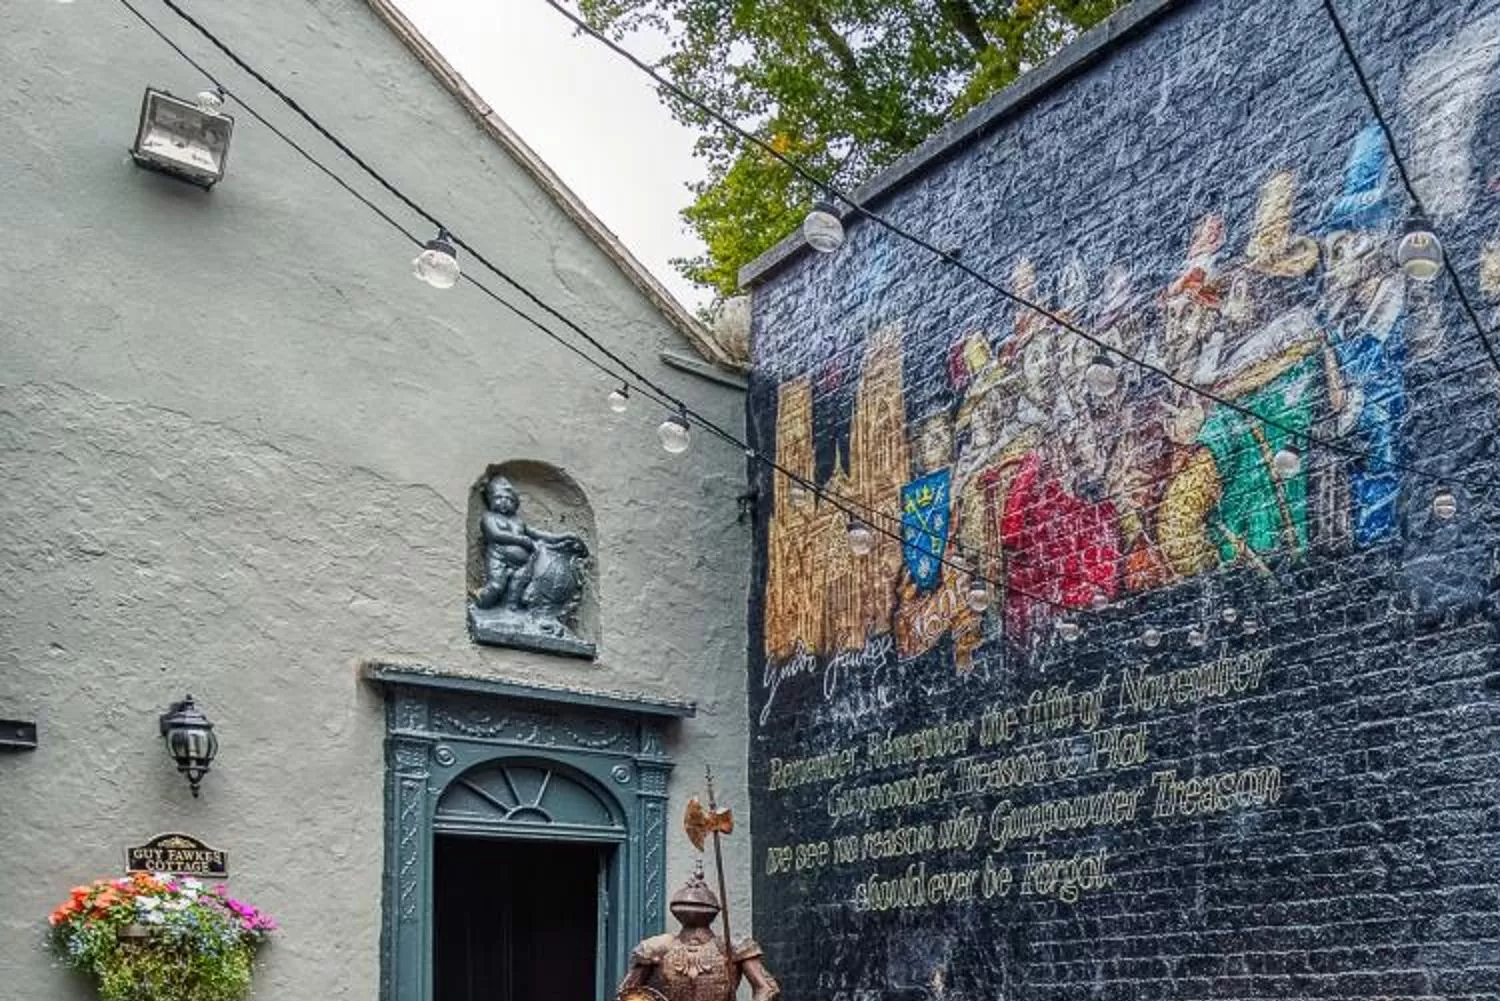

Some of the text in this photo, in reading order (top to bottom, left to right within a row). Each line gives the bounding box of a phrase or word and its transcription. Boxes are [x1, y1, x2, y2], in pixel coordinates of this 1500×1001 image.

[1113, 642, 1271, 718] November
[952, 750, 1050, 794] Treason
[1085, 723, 1150, 773] Plot
[795, 840, 830, 871] see
[862, 823, 936, 861] reason
[990, 790, 1146, 852] Gunpowder
[1151, 765, 1283, 819] Treason
[133, 849, 222, 865] GUY FAWKES
[145, 860, 209, 873] COTTAGE
[927, 867, 978, 905] ever
[980, 855, 1013, 900] be
